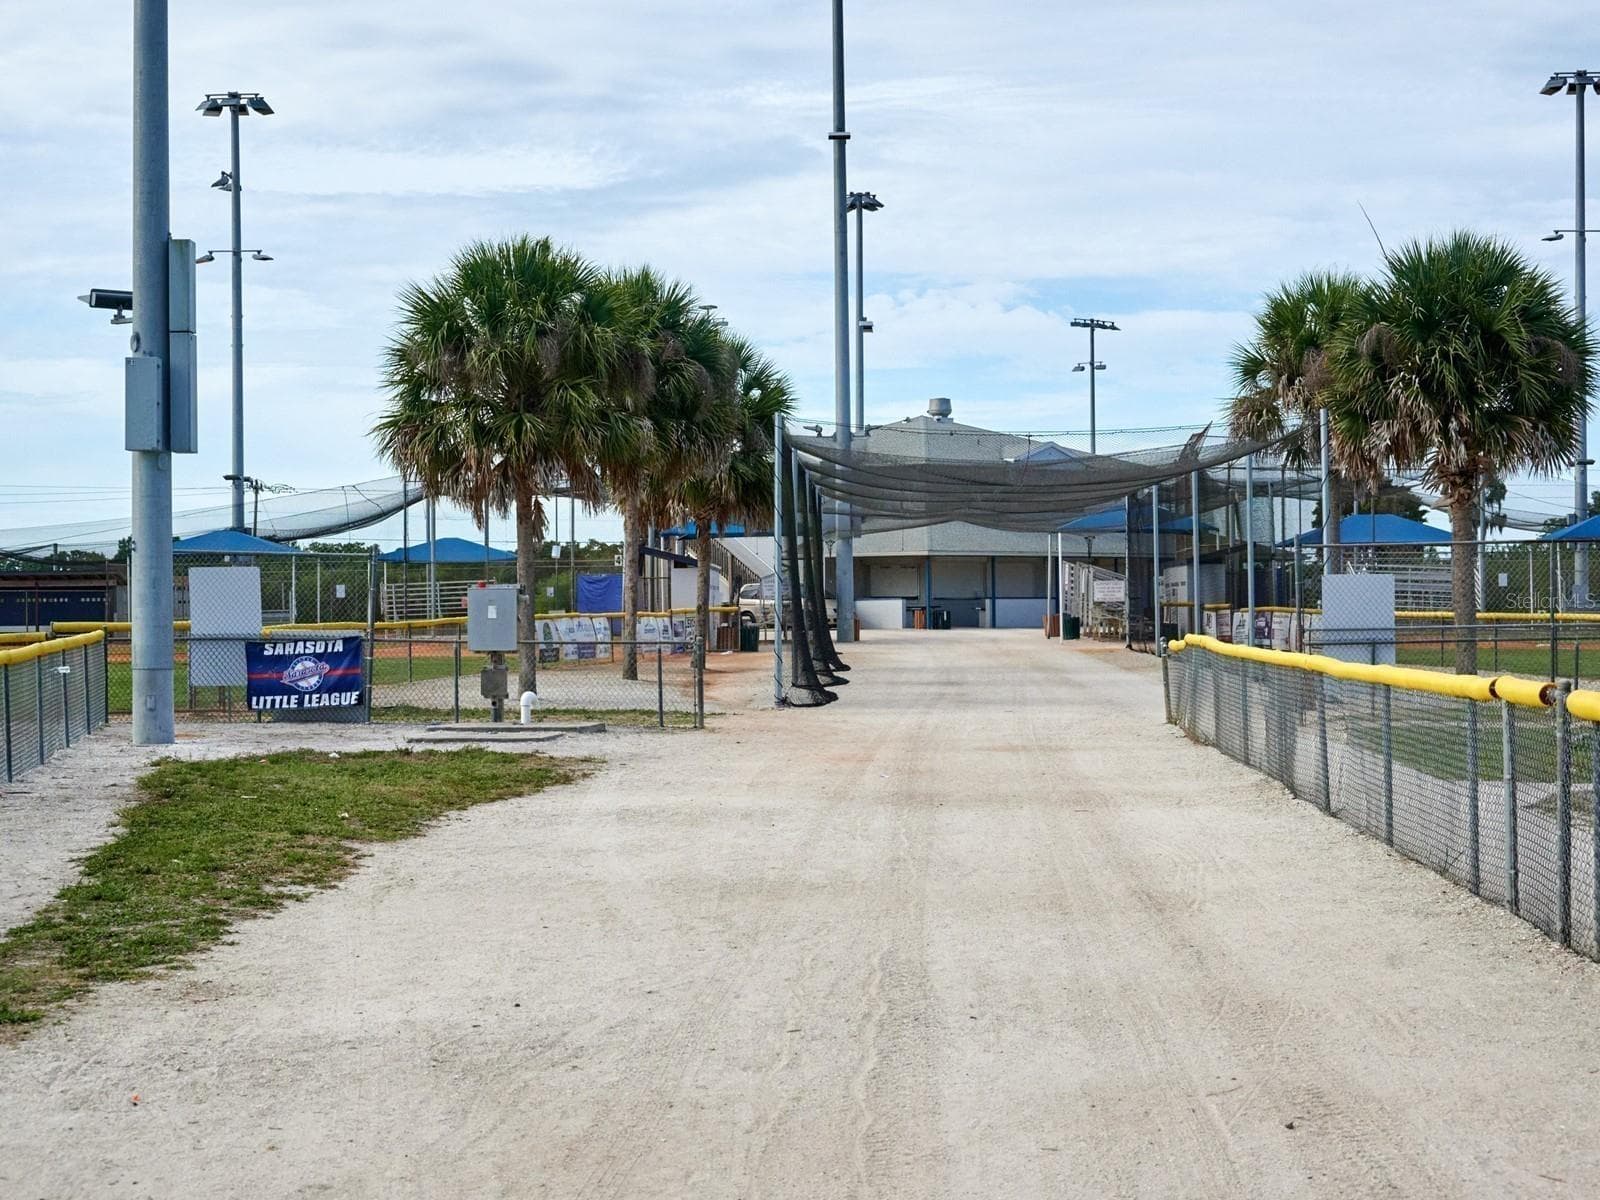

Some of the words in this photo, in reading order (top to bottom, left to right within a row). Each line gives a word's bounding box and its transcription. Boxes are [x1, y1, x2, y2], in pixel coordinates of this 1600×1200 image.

[263, 640, 343, 655] SARASOTA
[252, 696, 298, 709] LITTLE
[303, 692, 359, 707] LEAGUE
